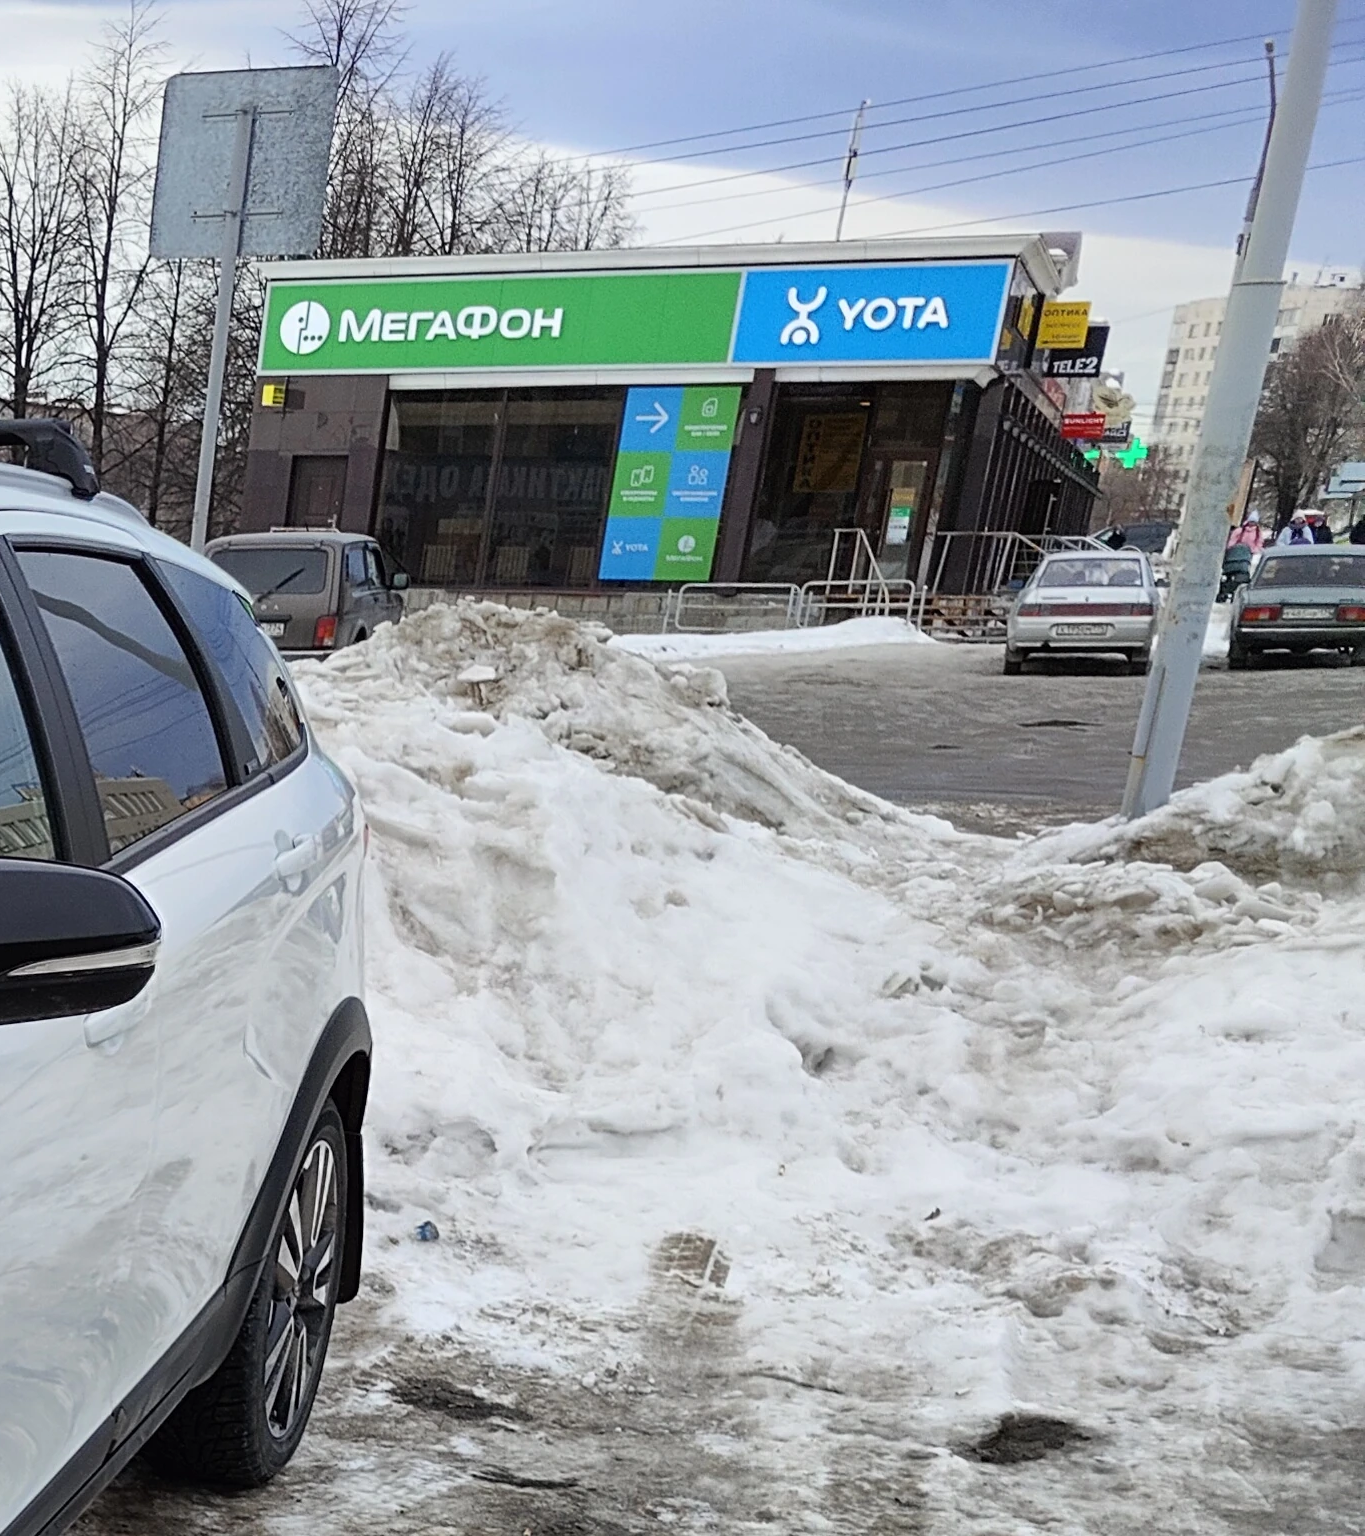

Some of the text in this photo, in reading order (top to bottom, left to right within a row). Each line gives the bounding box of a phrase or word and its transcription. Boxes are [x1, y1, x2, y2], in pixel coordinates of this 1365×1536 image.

[838, 297, 949, 331] YOTA
[1044, 308, 1089, 317] ОПТИКА
[1052, 356, 1098, 374] TELE2
